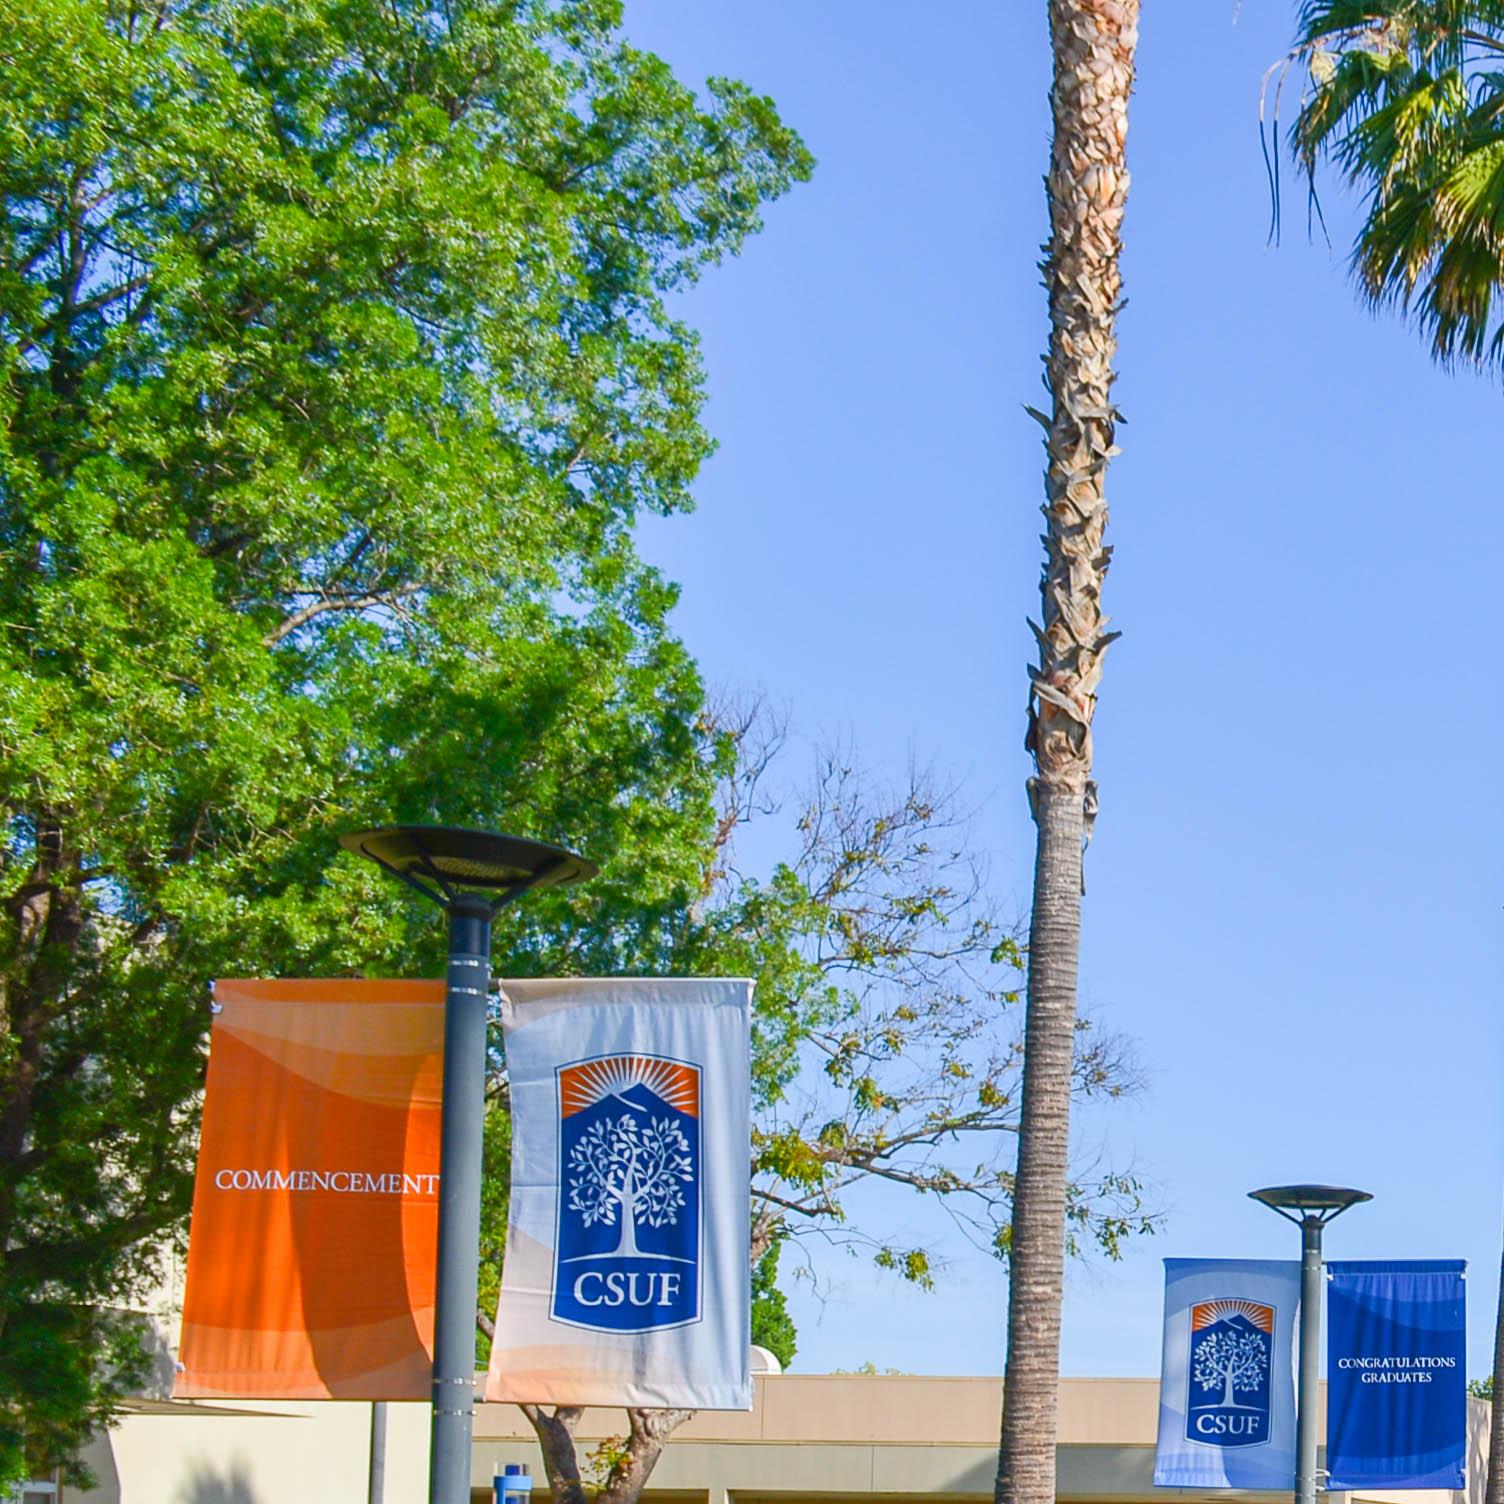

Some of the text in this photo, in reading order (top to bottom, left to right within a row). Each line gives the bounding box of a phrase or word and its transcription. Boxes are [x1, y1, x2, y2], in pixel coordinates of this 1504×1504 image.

[214, 1169, 440, 1196] COMMENCEMENT
[573, 1271, 682, 1307] CSUF
[1338, 1356, 1456, 1370] CONGRATULATIONS
[1361, 1371, 1433, 1384] GRADUATES
[1196, 1414, 1261, 1434] CSUF
